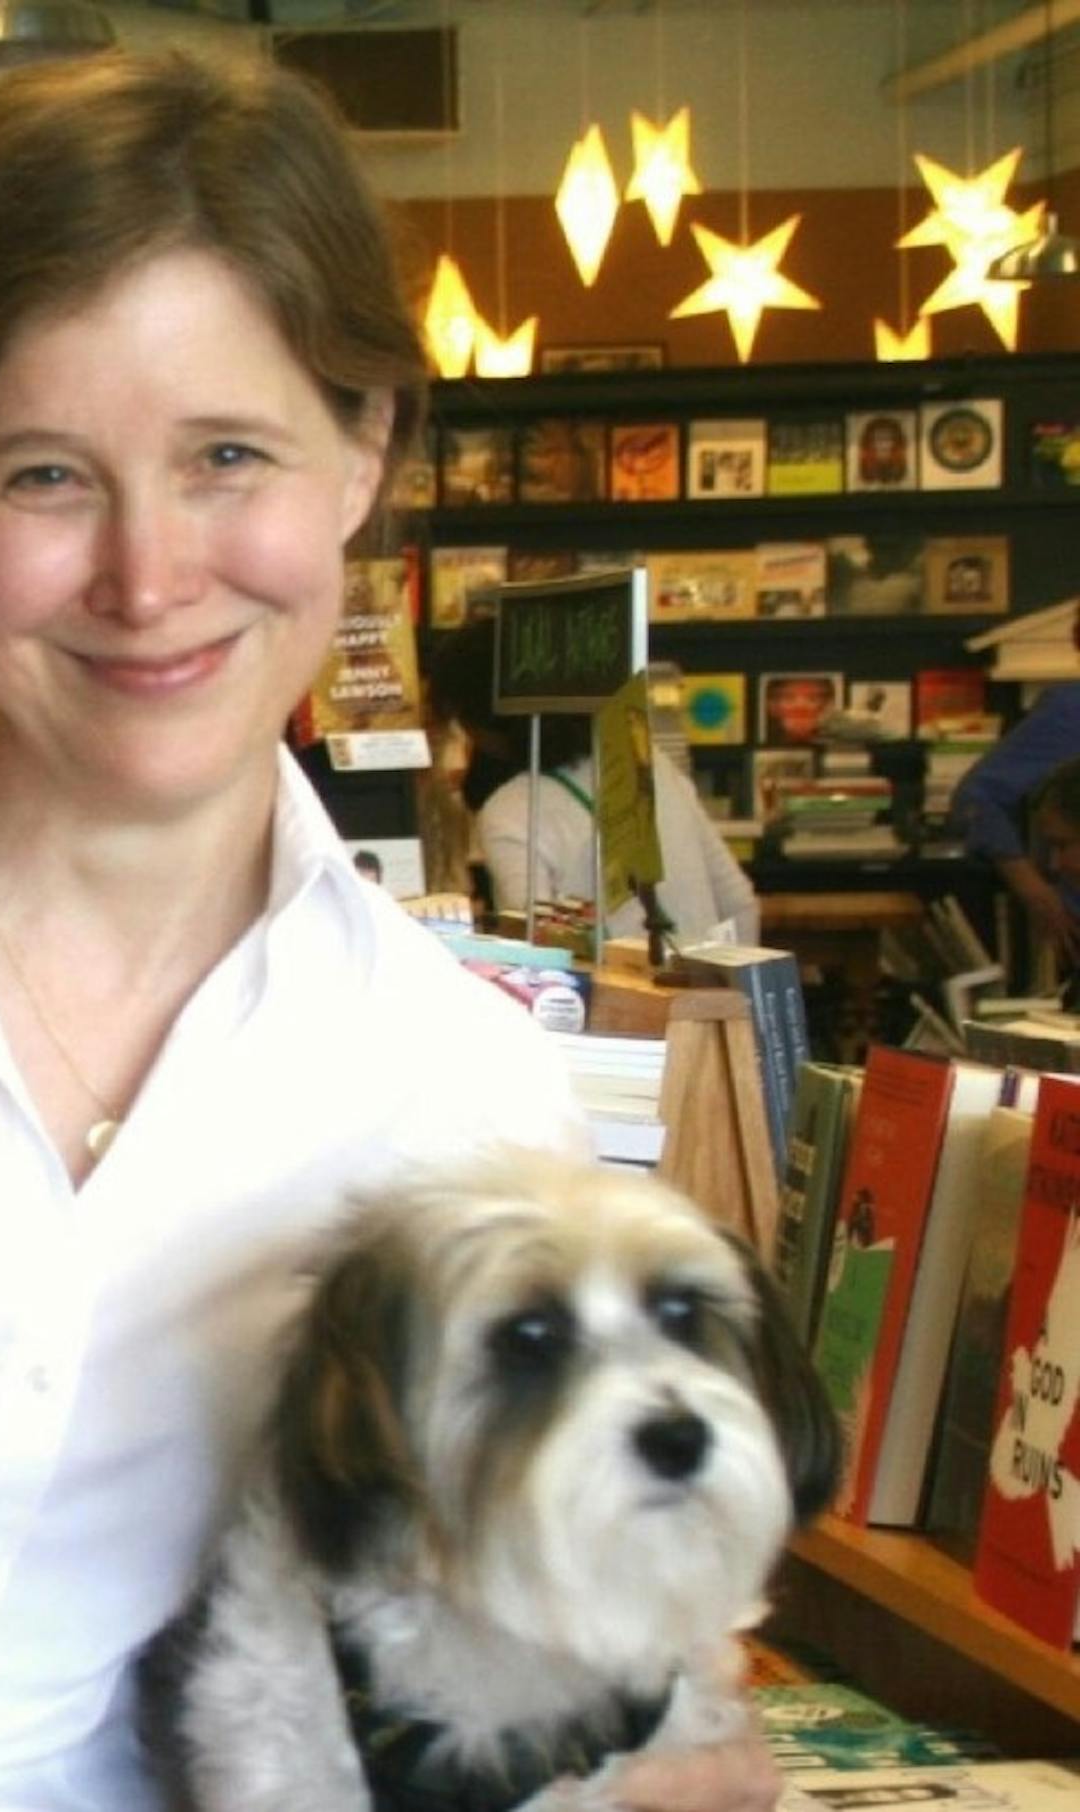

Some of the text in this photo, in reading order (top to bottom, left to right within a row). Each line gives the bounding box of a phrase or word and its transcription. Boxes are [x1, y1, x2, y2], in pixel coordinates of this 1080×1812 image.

[330, 631, 388, 649] HAPPY
[328, 682, 403, 700] LAWSON
[1030, 1356, 1065, 1406] GOD
[1012, 1437, 1063, 1501] RUINS
